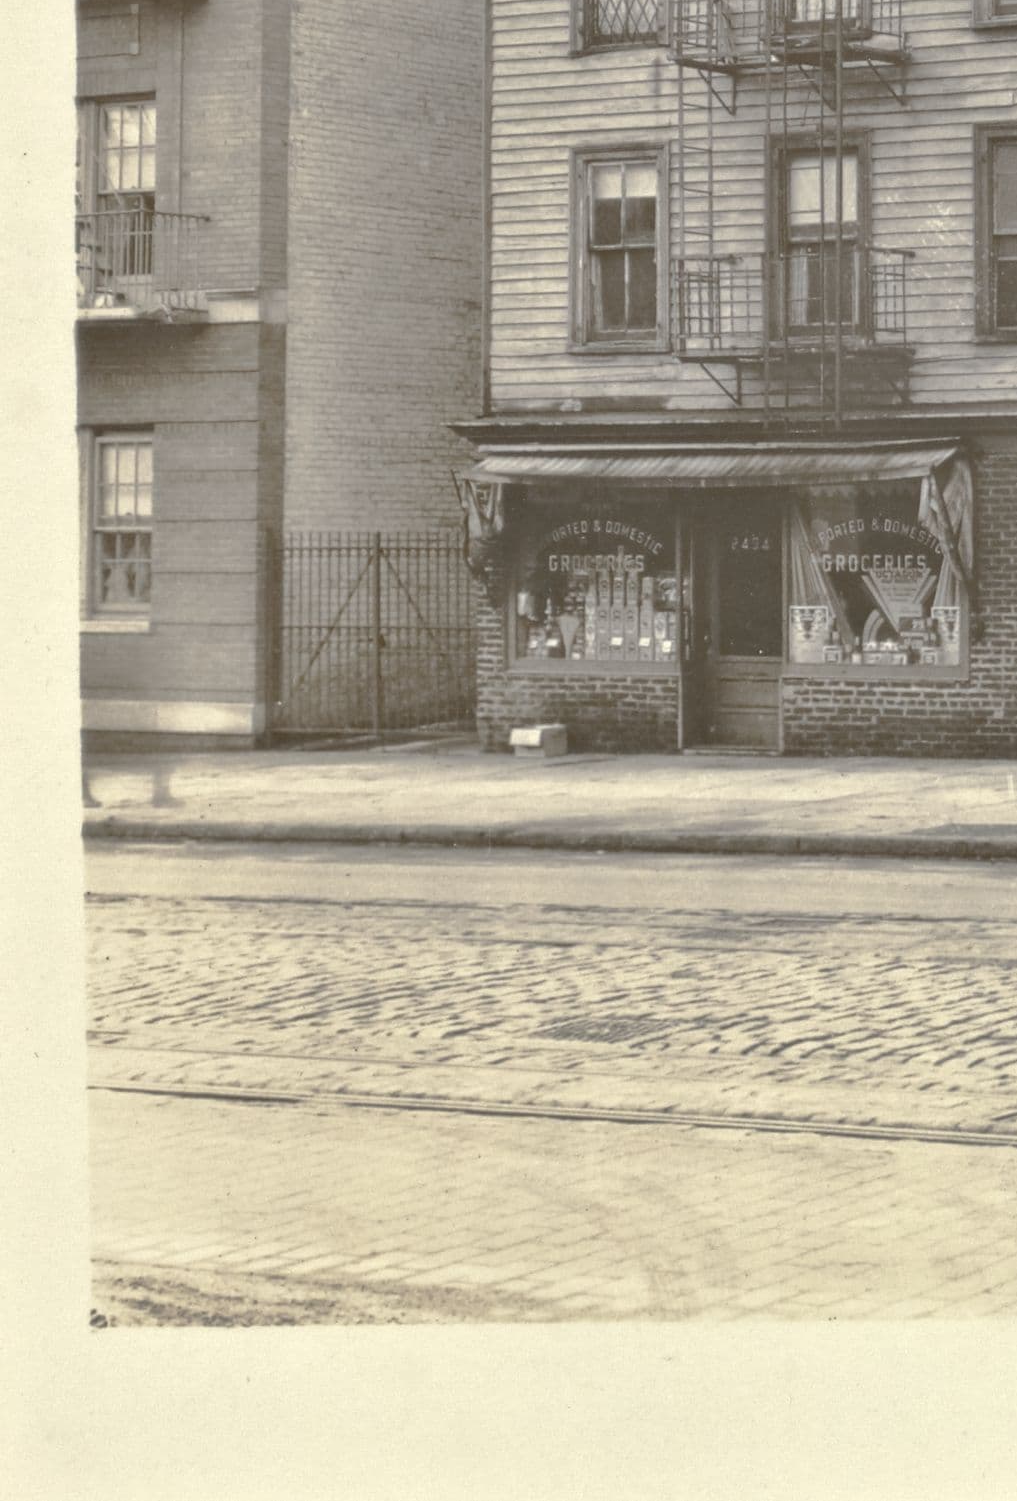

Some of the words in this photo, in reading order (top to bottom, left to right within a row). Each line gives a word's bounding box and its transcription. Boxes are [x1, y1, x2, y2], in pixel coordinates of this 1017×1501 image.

[605, 520, 664, 555] DOMESTIC
[549, 554, 645, 573] GROCERIES
[821, 553, 928, 573] GROCERIES
